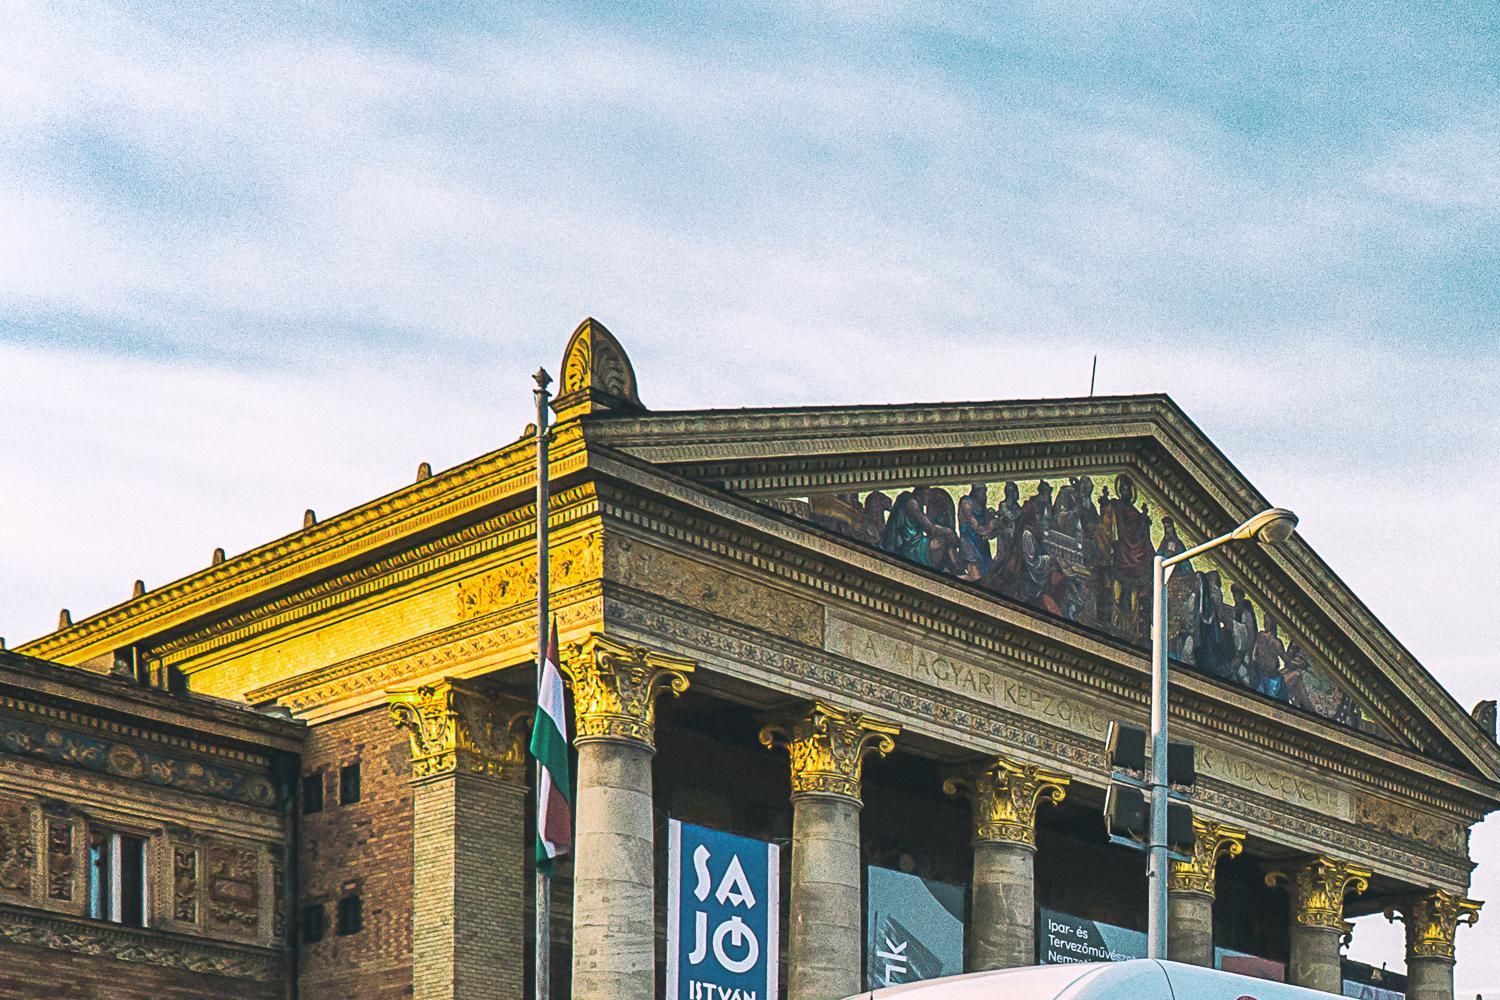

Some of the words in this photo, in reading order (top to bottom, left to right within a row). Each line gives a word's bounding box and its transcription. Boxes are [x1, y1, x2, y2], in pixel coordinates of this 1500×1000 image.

[693, 844, 757, 910] SA
[1048, 918, 1074, 933] Ipar-
[1076, 926, 1088, 939] és
